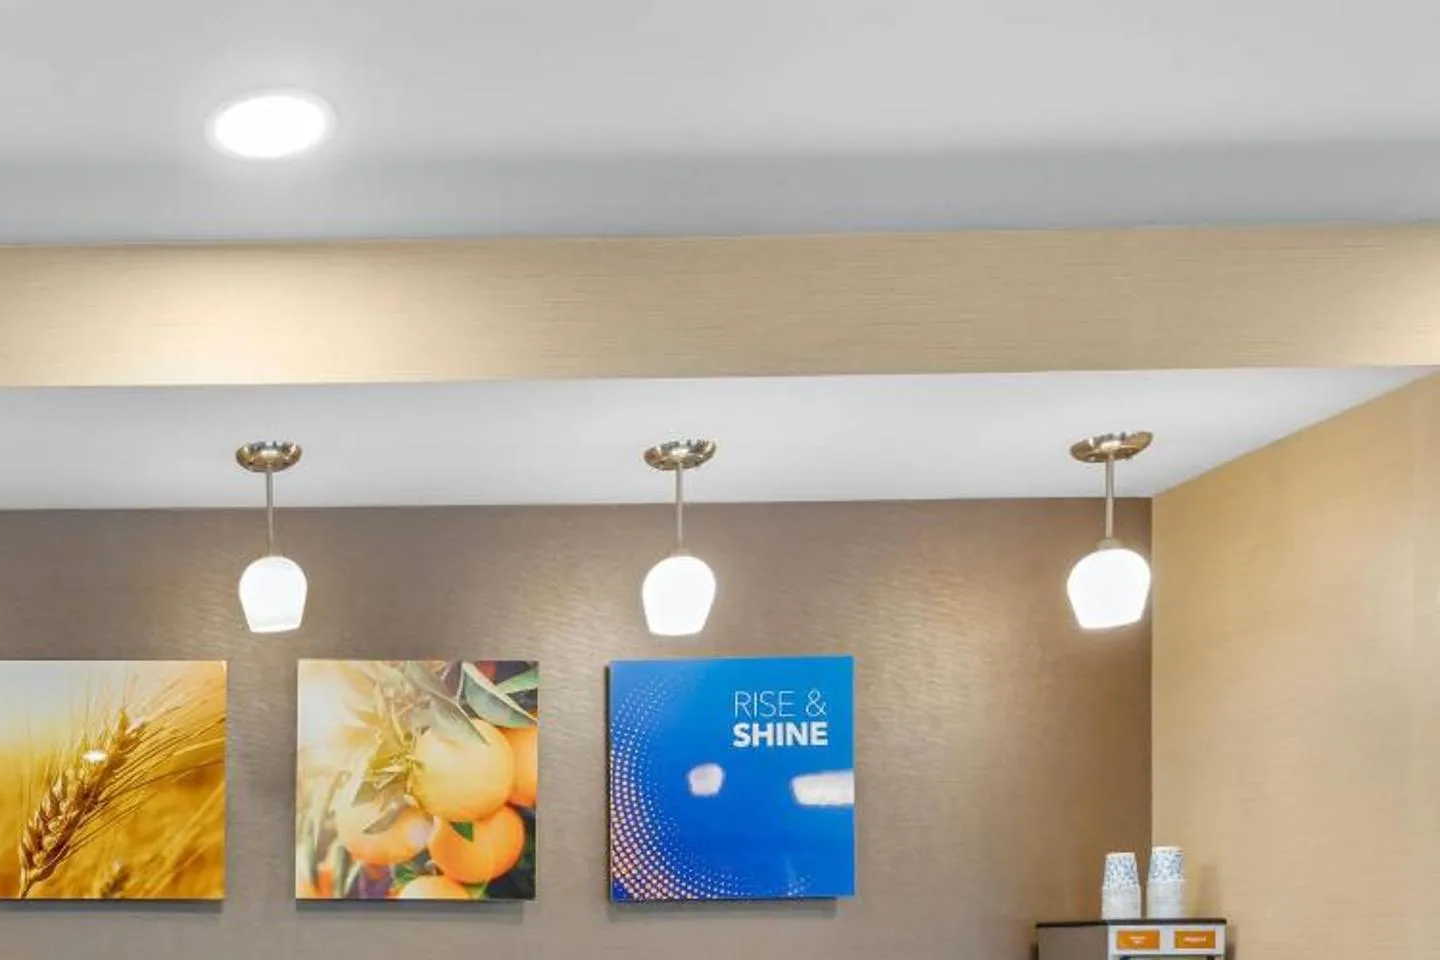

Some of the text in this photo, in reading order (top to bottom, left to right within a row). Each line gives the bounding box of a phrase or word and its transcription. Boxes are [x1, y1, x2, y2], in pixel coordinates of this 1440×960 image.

[733, 689, 827, 718] RISE &
[732, 721, 829, 748] SHINE
